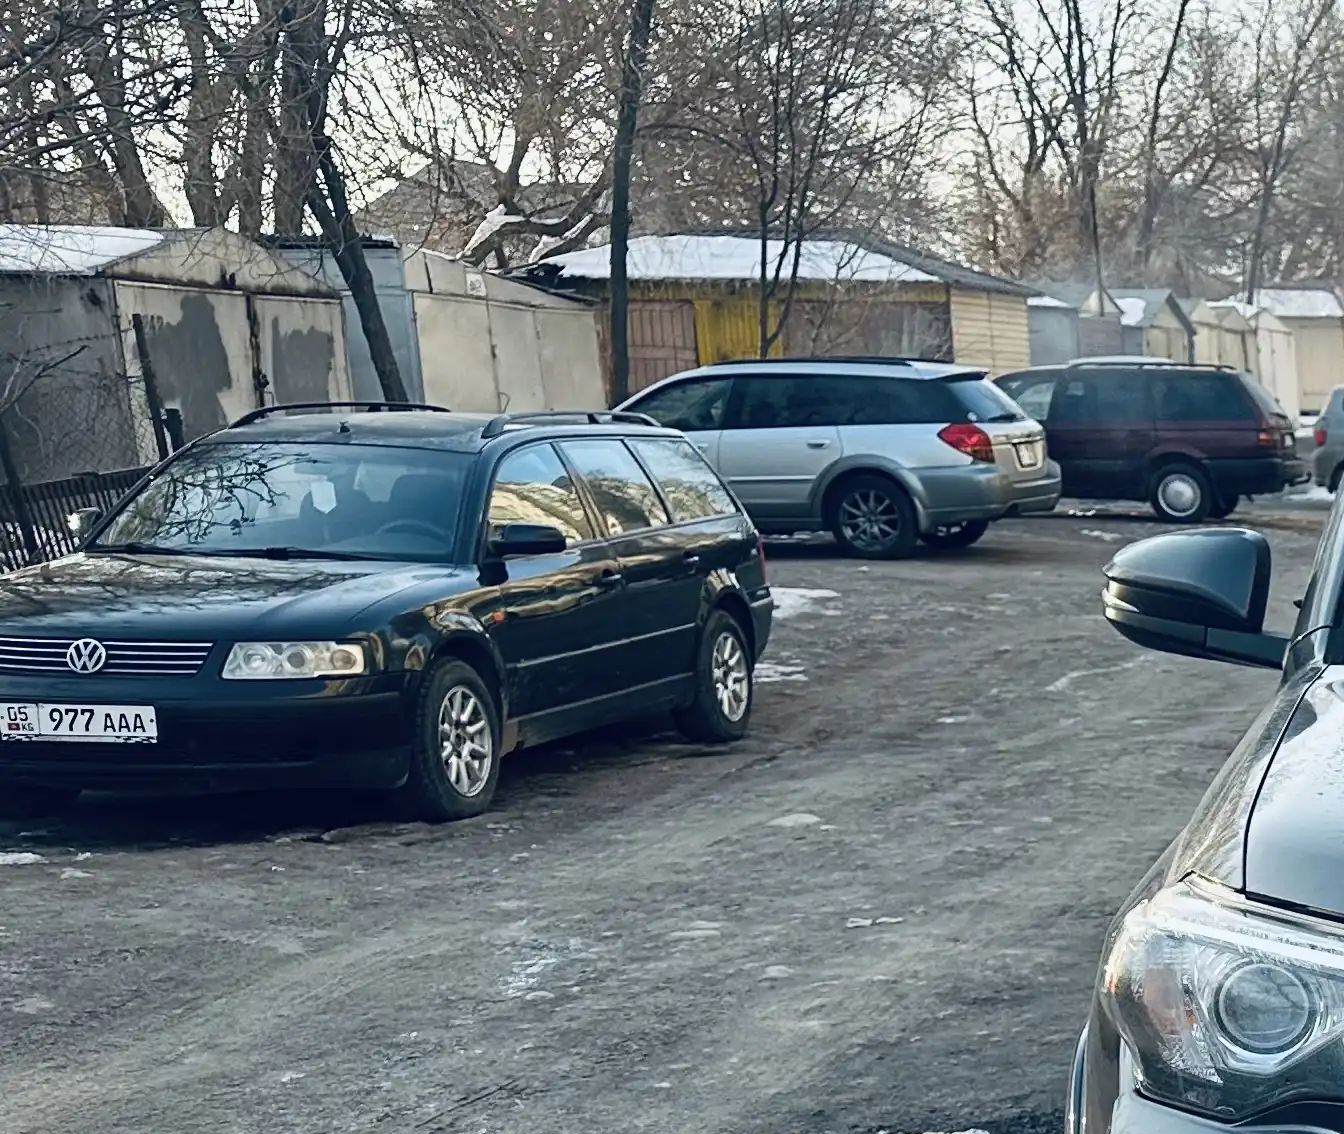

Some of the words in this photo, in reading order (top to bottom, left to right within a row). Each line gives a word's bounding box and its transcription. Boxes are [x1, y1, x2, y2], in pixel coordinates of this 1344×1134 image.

[7, 706, 28, 722] 05
[49, 708, 95, 732] 977
[103, 712, 146, 733] AAA
[21, 722, 34, 732] KG
